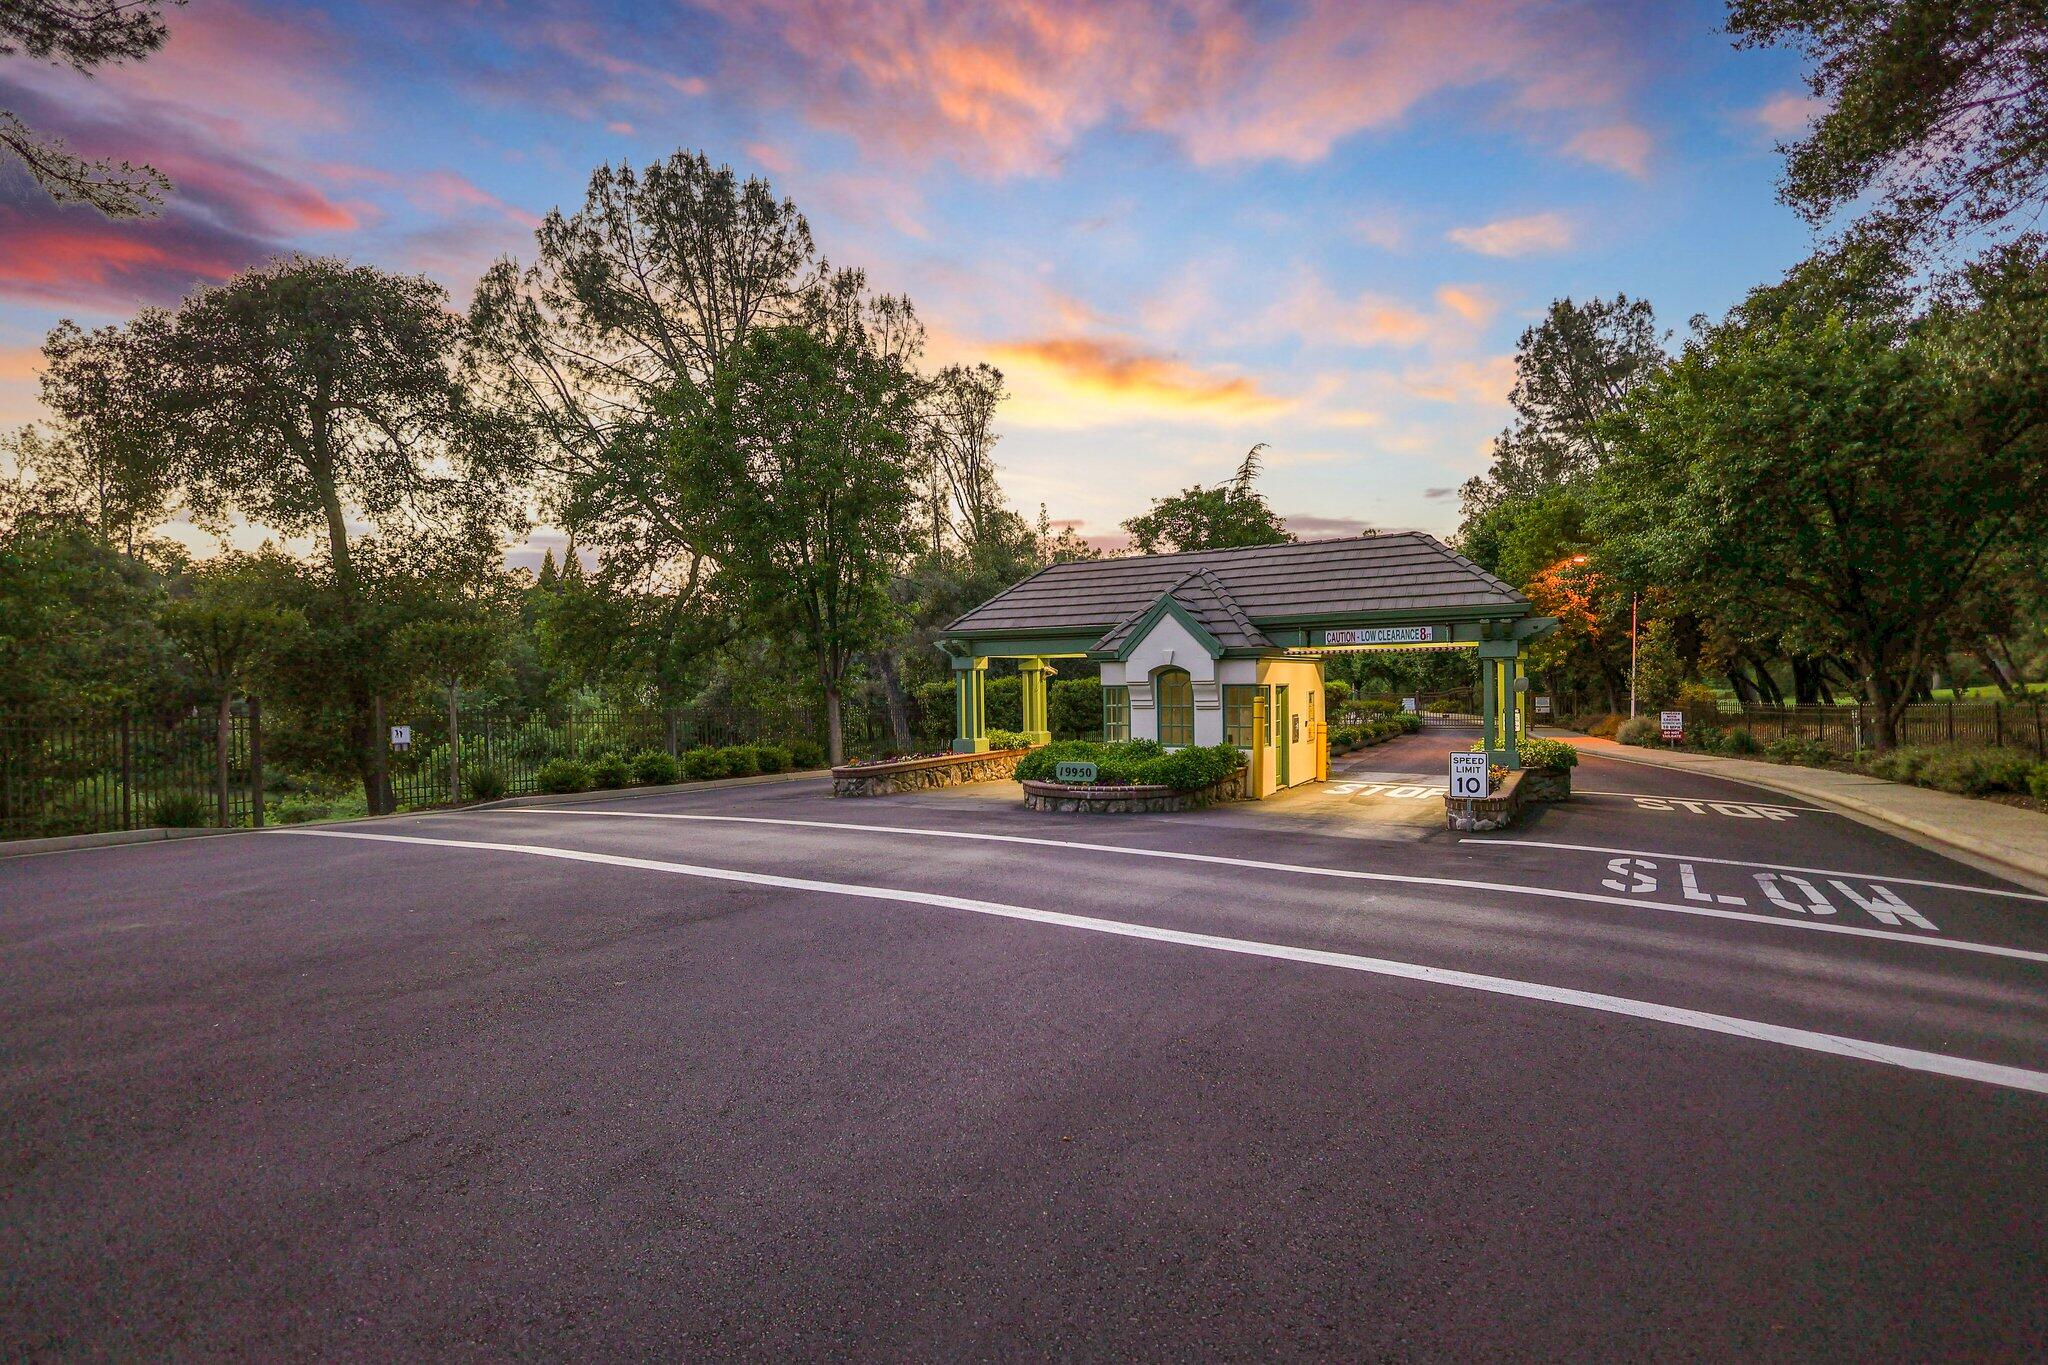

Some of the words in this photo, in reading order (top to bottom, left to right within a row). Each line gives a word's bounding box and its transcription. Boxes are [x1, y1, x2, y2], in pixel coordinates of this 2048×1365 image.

[1326, 631, 1356, 643] CAUTION
[1361, 630, 1377, 641] LOW
[1377, 628, 1419, 641] CLEARANCE
[1453, 757, 1484, 765] SPEED
[1060, 767, 1092, 777] 19950
[1457, 777, 1480, 793] 10
[1633, 798, 1799, 821] STOP
[1602, 858, 1940, 931] SLOW
